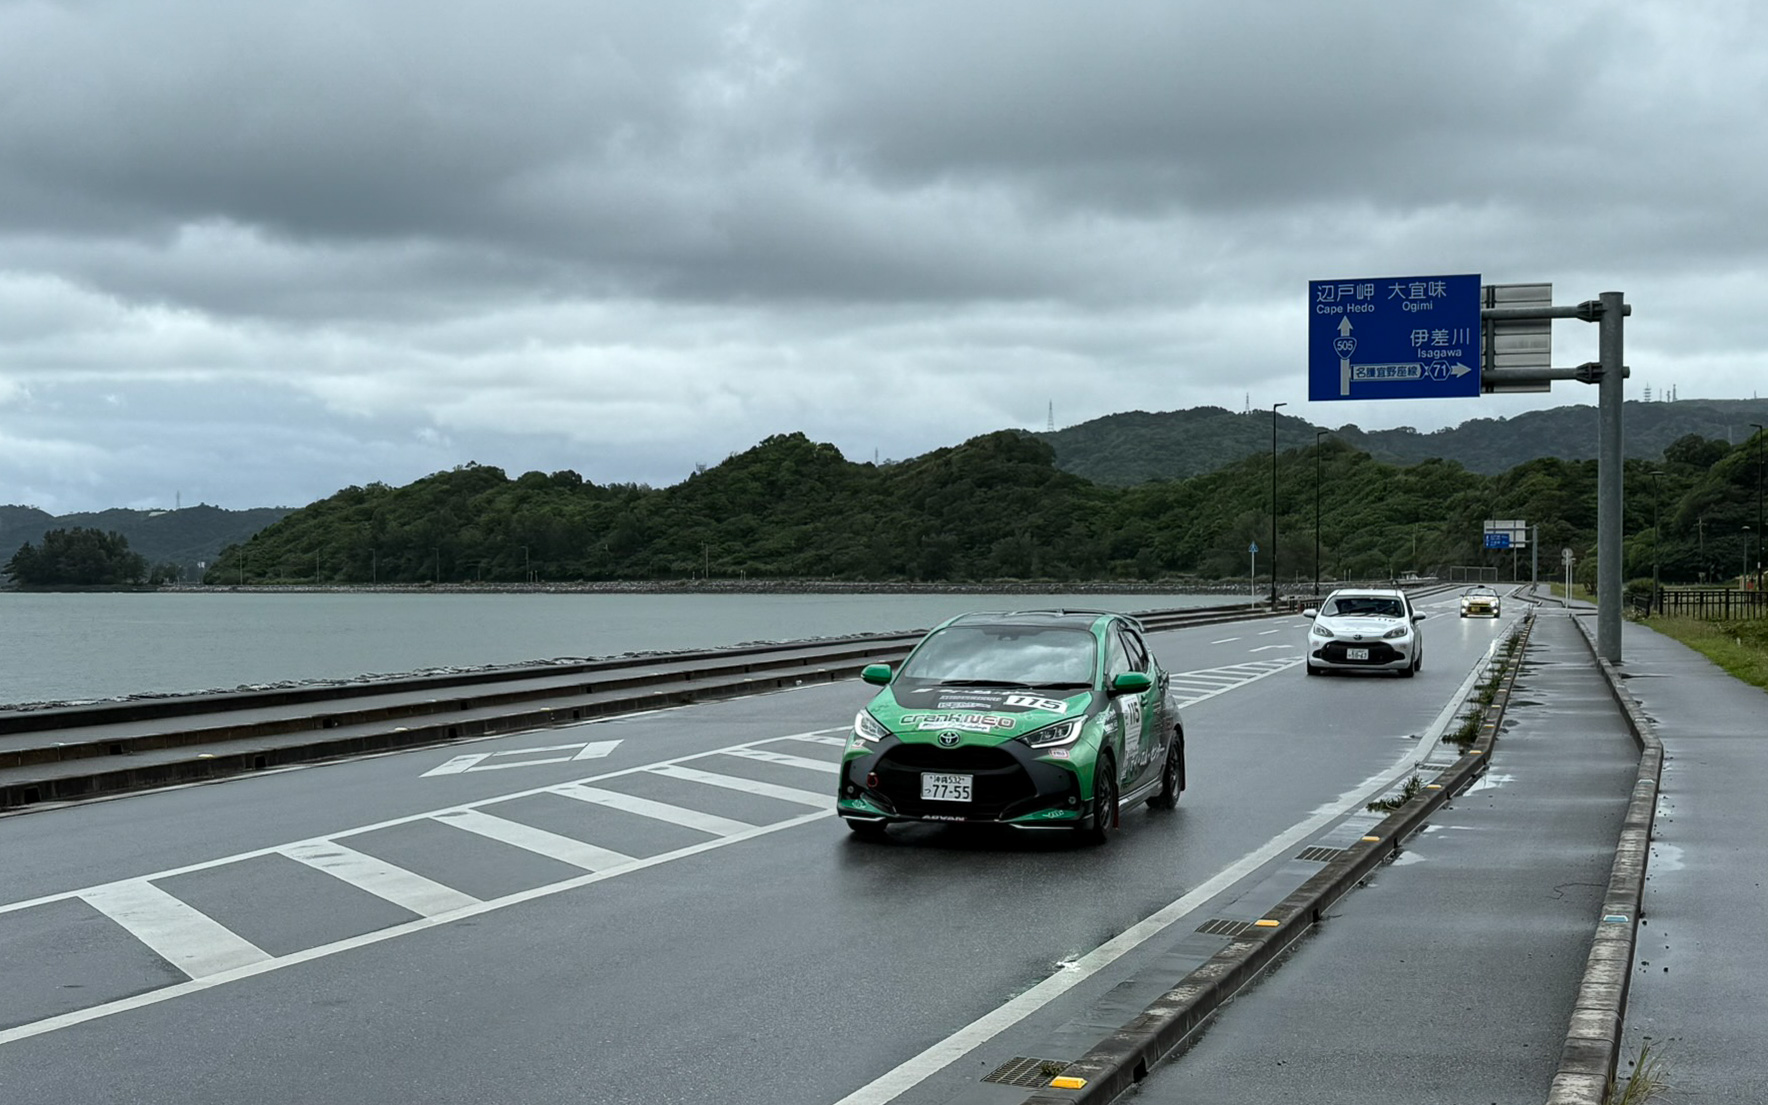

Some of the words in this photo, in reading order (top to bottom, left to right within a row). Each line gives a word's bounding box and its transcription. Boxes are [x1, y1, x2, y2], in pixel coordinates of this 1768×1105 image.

[1316, 284, 1375, 303] 辺戸岬
[1387, 280, 1447, 300] 大宜味
[1316, 304, 1343, 315] Cape
[1347, 303, 1375, 313] Hedo
[1402, 301, 1433, 313] Ogimi
[1337, 339, 1354, 351] 505
[1410, 328, 1470, 347] 伊差川
[1417, 348, 1462, 360] Isagawa
[1433, 365, 1446, 377] 71
[1014, 696, 1061, 711] 115
[1127, 702, 1140, 726] 115
[932, 784, 970, 800] 77-55
